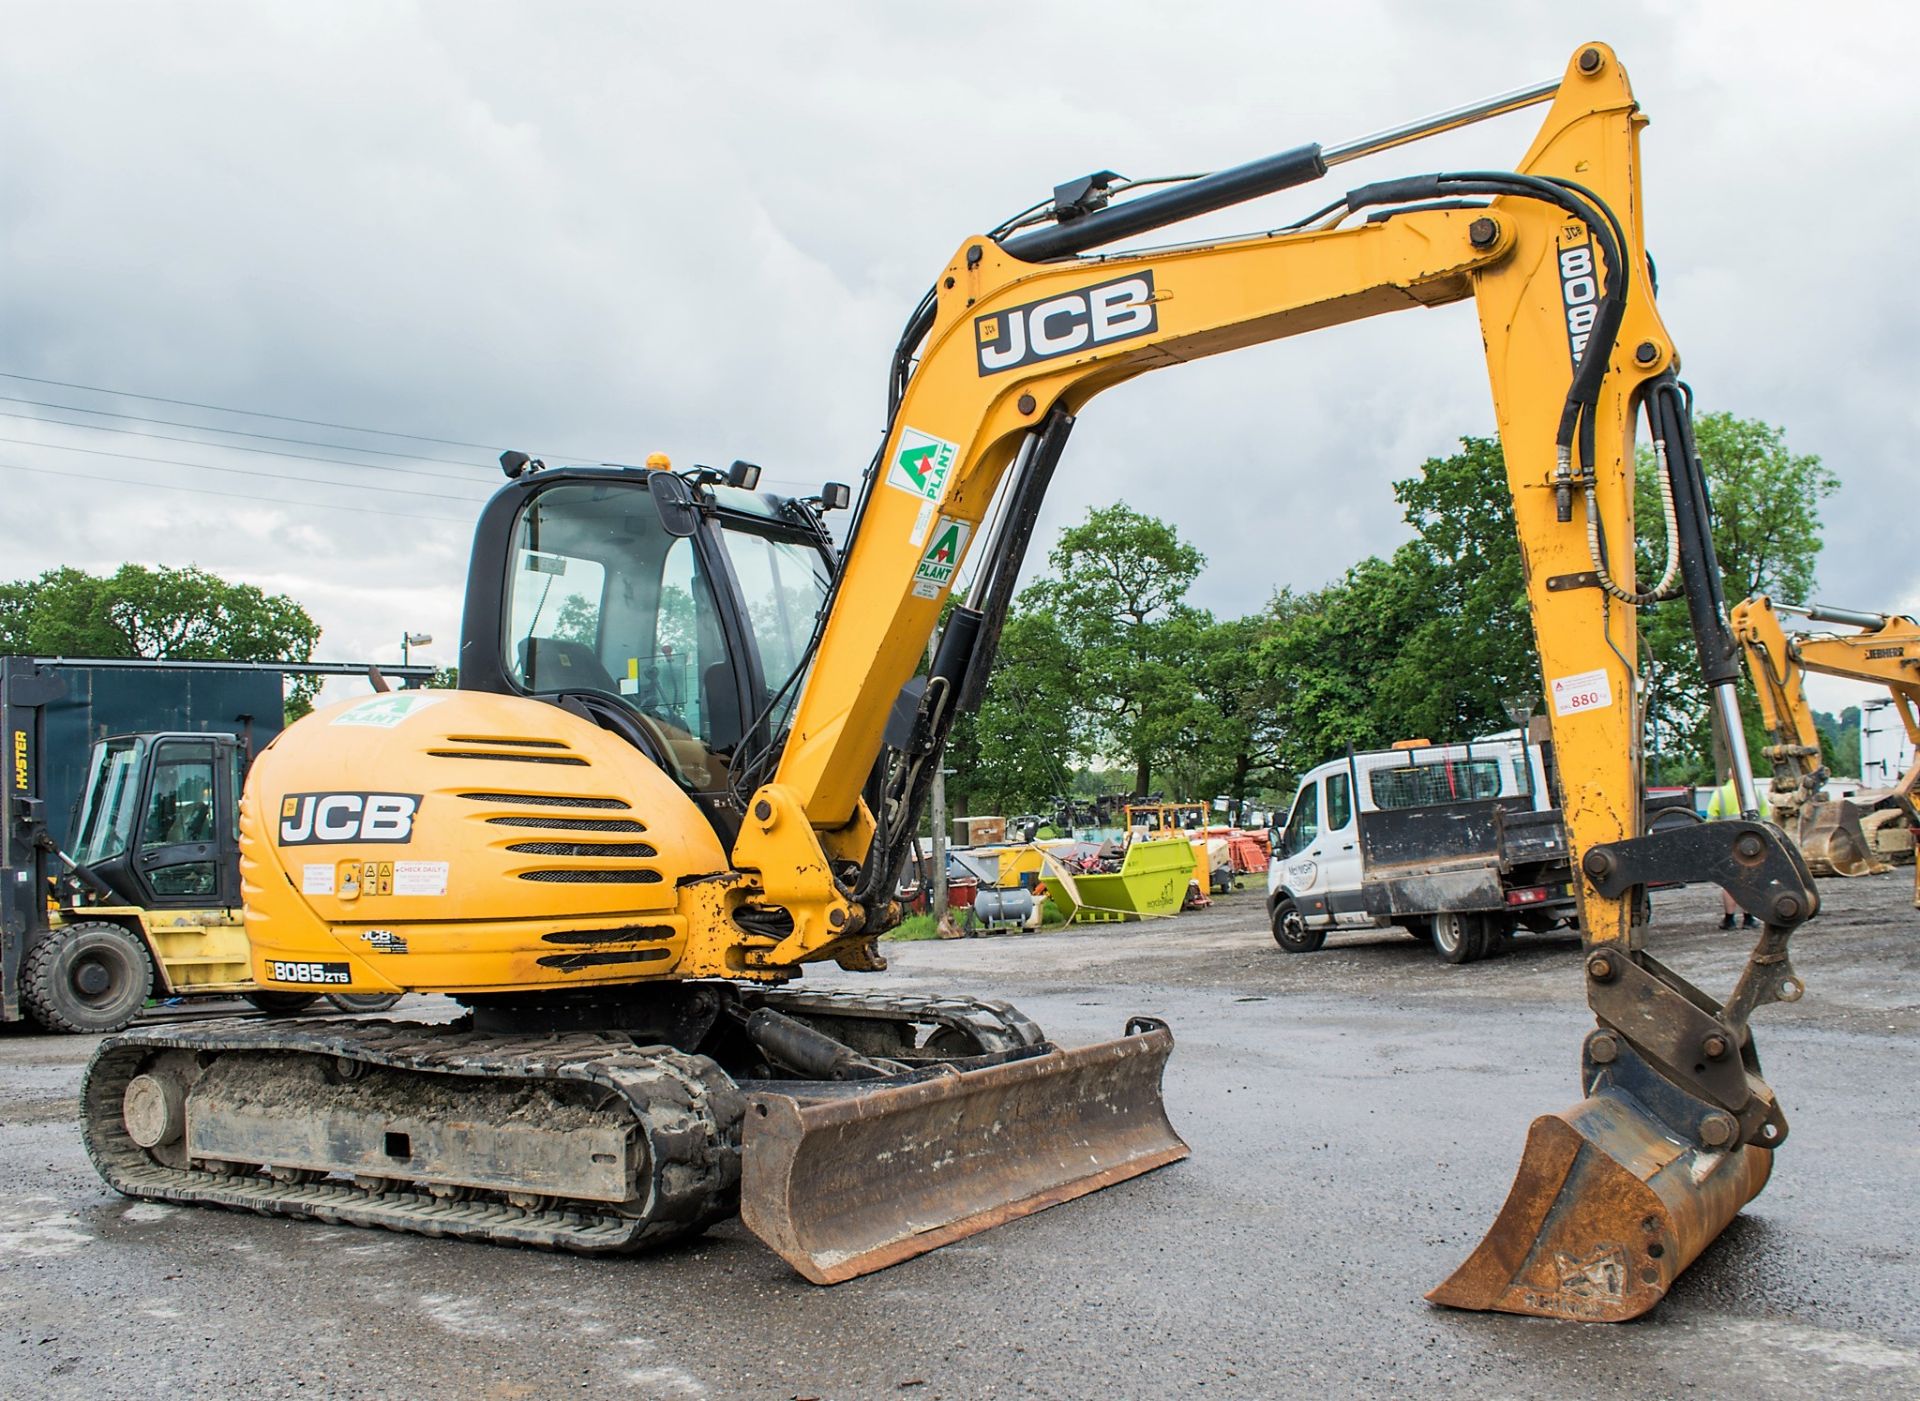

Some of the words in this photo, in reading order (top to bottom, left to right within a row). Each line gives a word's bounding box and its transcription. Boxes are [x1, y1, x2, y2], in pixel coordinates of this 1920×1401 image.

[981, 278, 1153, 370] JCB
[926, 442, 953, 500] PLANT
[917, 562, 952, 581] PLANT
[1571, 692, 1599, 708] 880
[15, 730, 28, 790] HYSTER
[281, 795, 416, 842] JCB
[360, 930, 391, 941] JCB
